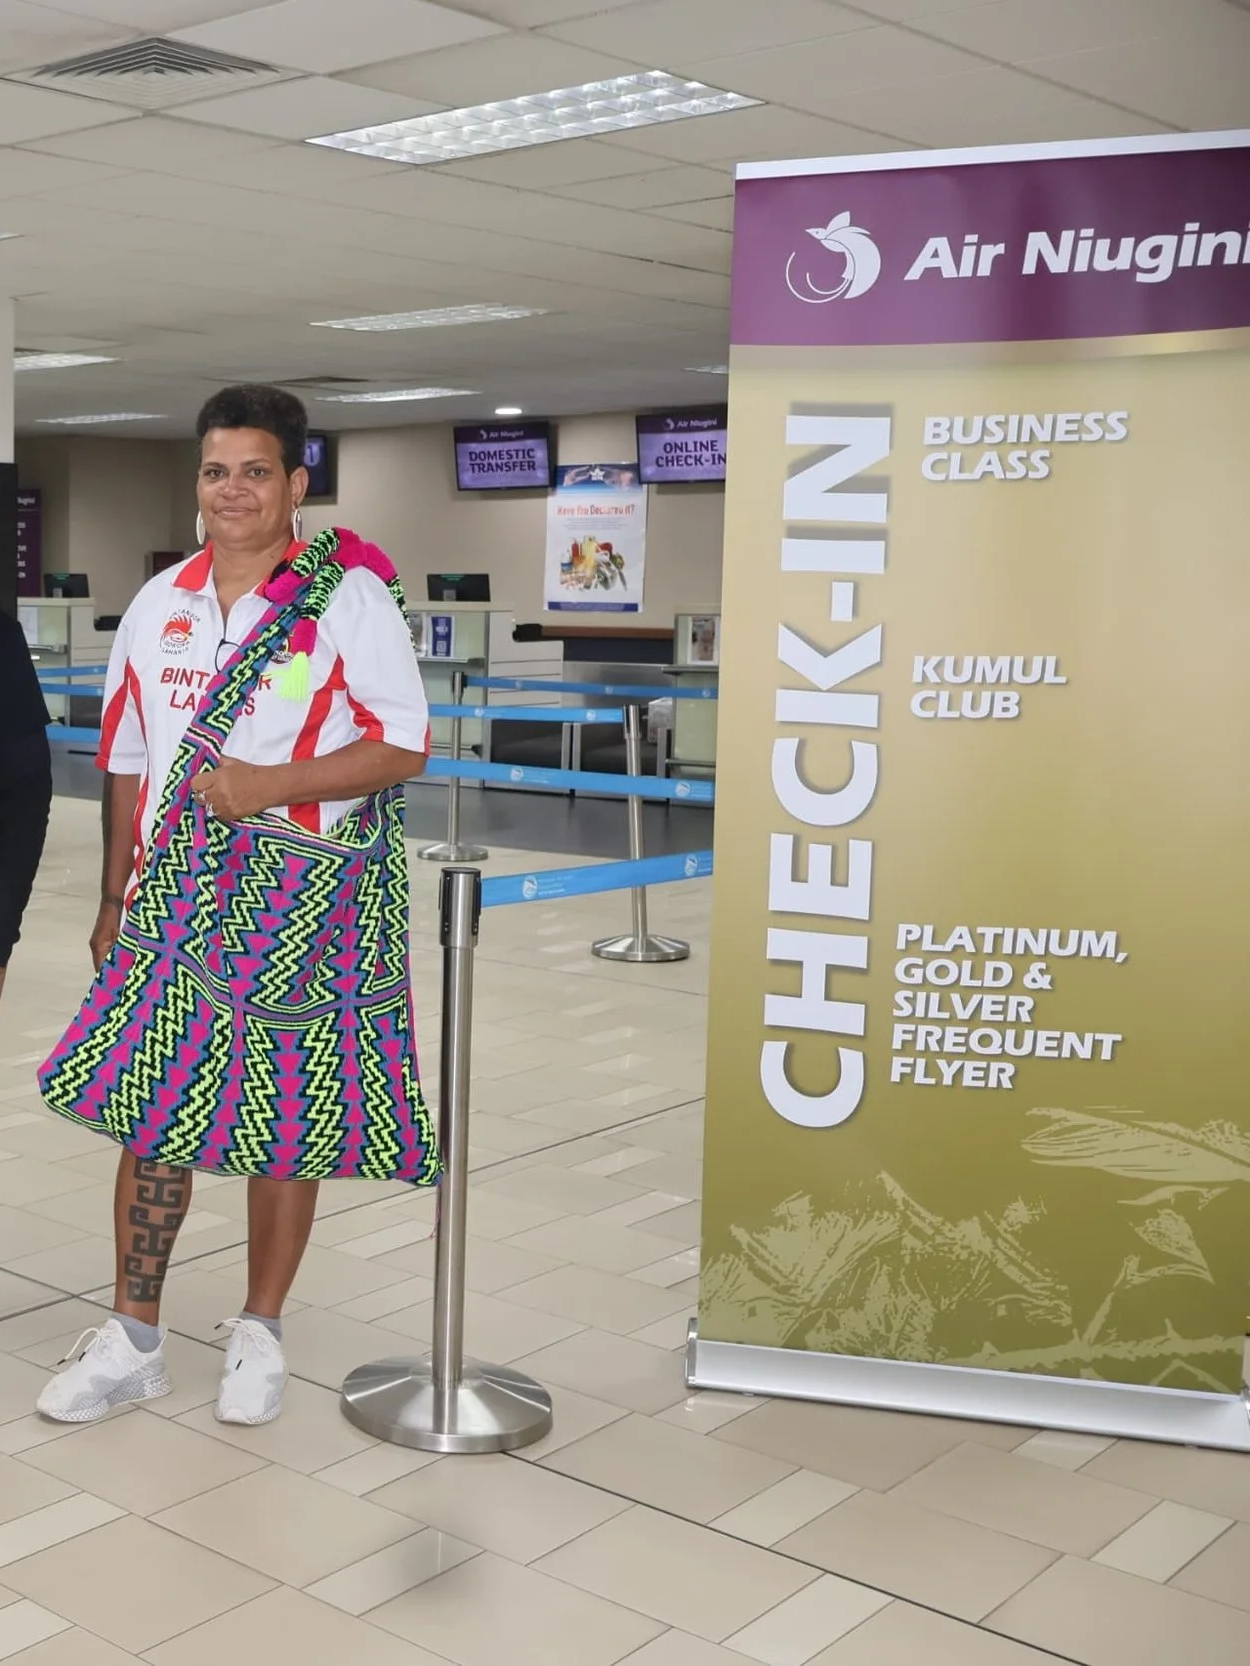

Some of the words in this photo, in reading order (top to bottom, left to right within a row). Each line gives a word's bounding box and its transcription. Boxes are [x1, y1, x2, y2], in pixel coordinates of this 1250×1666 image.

[903, 234, 1006, 281] Air
[923, 411, 1129, 445] BUSINESS
[468, 448, 536, 461] DOMESTIC
[655, 453, 726, 467] CHECK-IN
[663, 440, 719, 454] ONLINE
[468, 460, 537, 474] TRANSFER
[921, 449, 1052, 481] CLASS
[160, 667, 272, 691] BINTR
[911, 655, 1068, 685] KUMUL
[910, 690, 1021, 719] CLUB
[760, 415, 892, 1128] CHECK-IN
[895, 923, 1129, 964] PLATINUM,
[894, 957, 1014, 988] GOLD
[1022, 961, 1054, 990] &
[892, 990, 1035, 1023] SILVER
[891, 1023, 1123, 1061] FREQUENT
[890, 1056, 1017, 1089] FLYER
